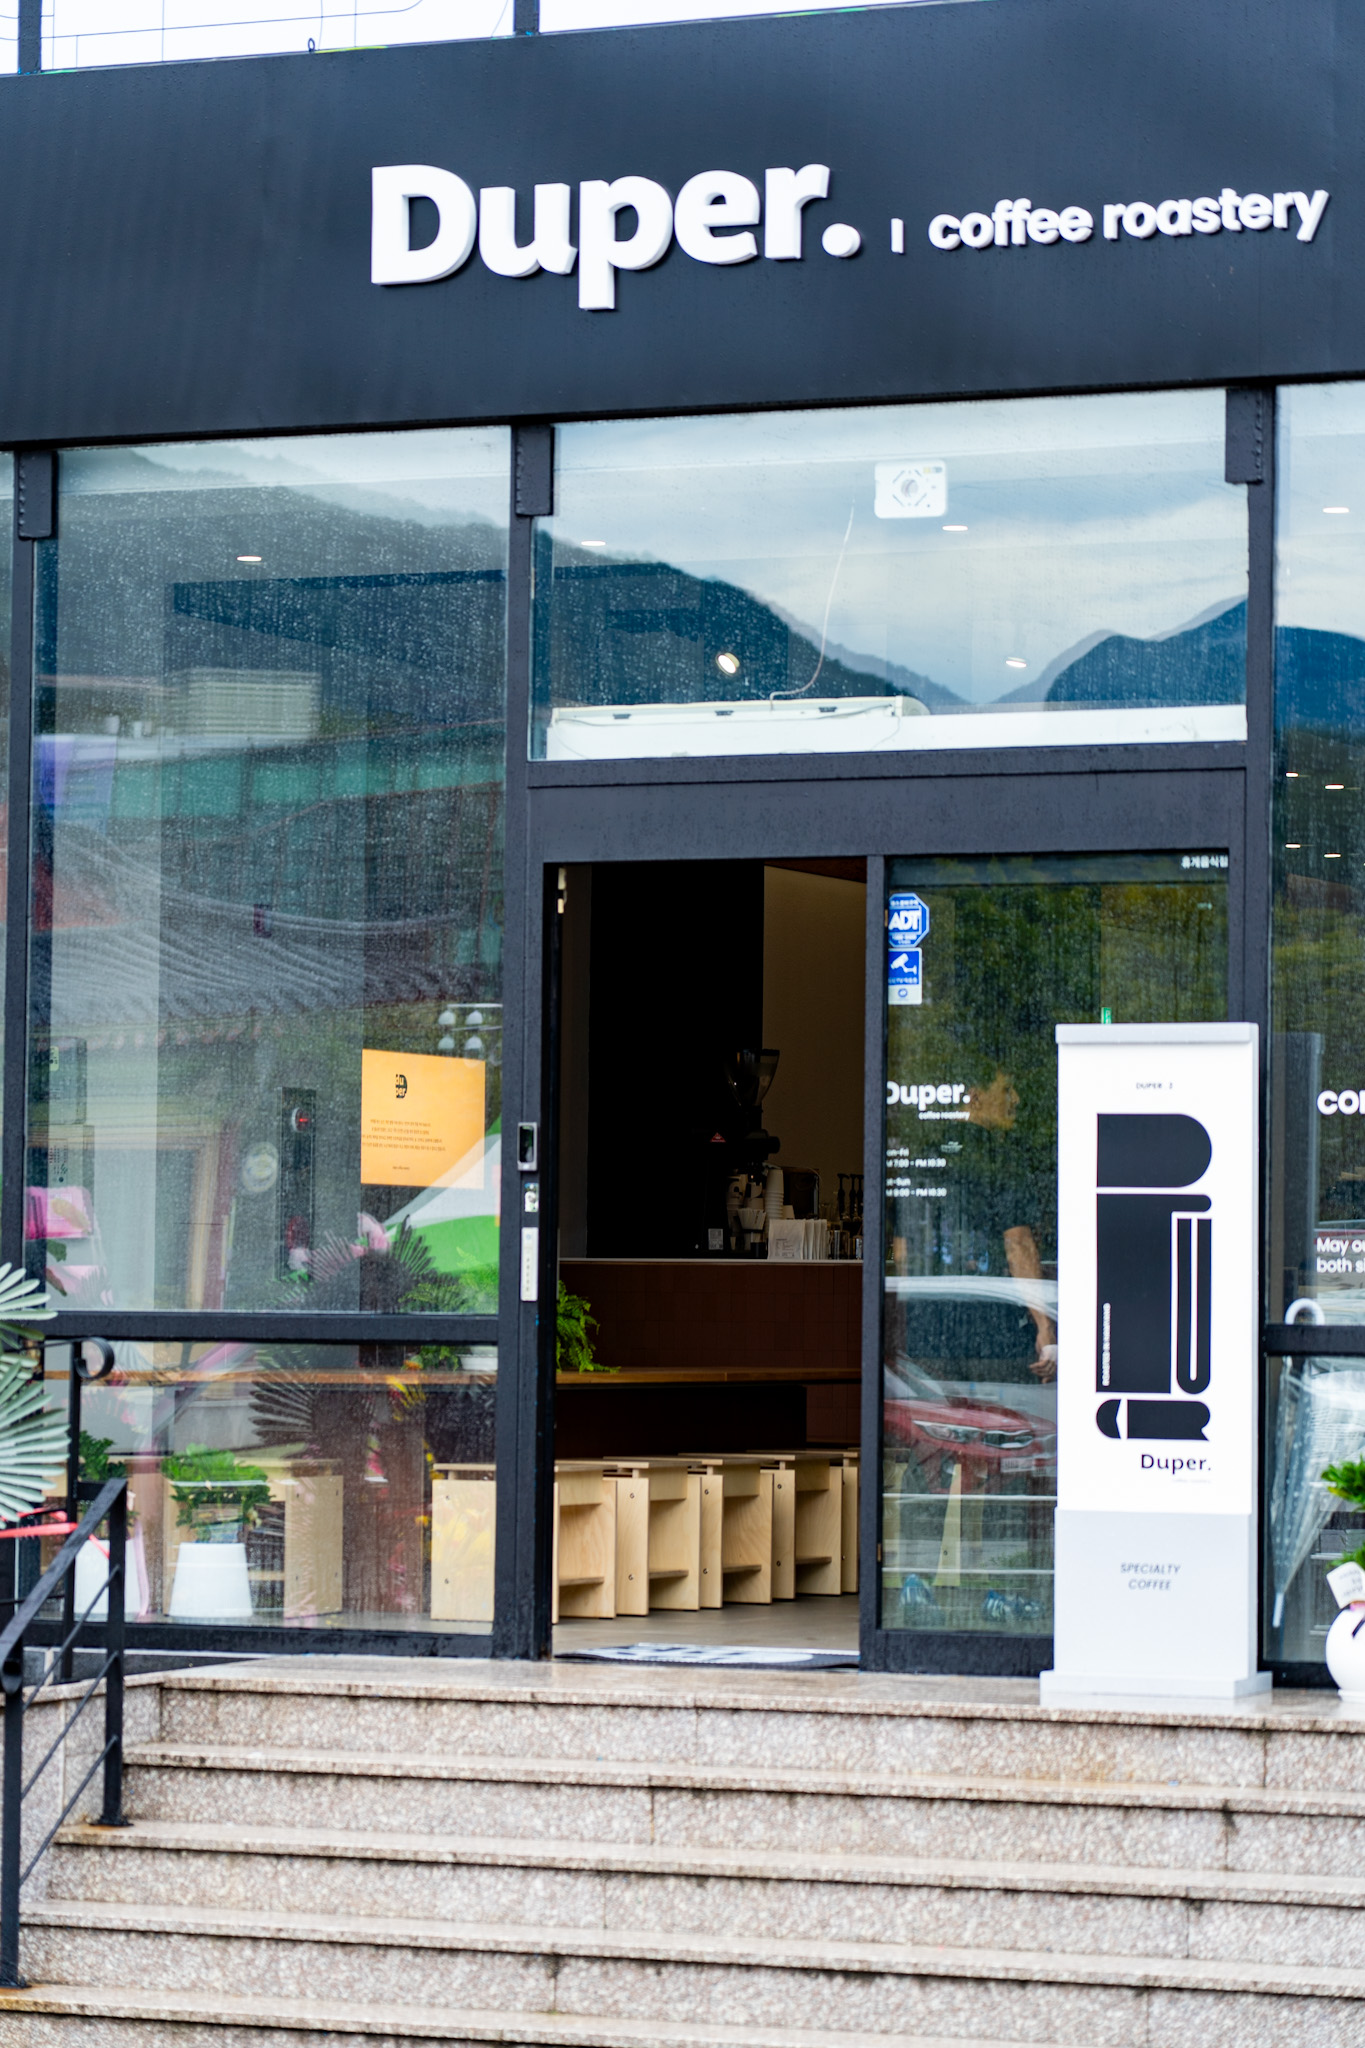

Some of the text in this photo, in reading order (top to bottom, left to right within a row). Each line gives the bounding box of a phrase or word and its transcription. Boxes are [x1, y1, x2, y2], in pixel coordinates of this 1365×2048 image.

[370, 163, 1330, 311] Duper. coffee roastery
[888, 910, 921, 931] ADT
[1316, 1236, 1350, 1257] May
[1316, 1256, 1353, 1274] both
[1140, 1453, 1212, 1476] Duper.
[1120, 1562, 1181, 1575] SPECIALTY
[1128, 1579, 1172, 1590] COFFEE
